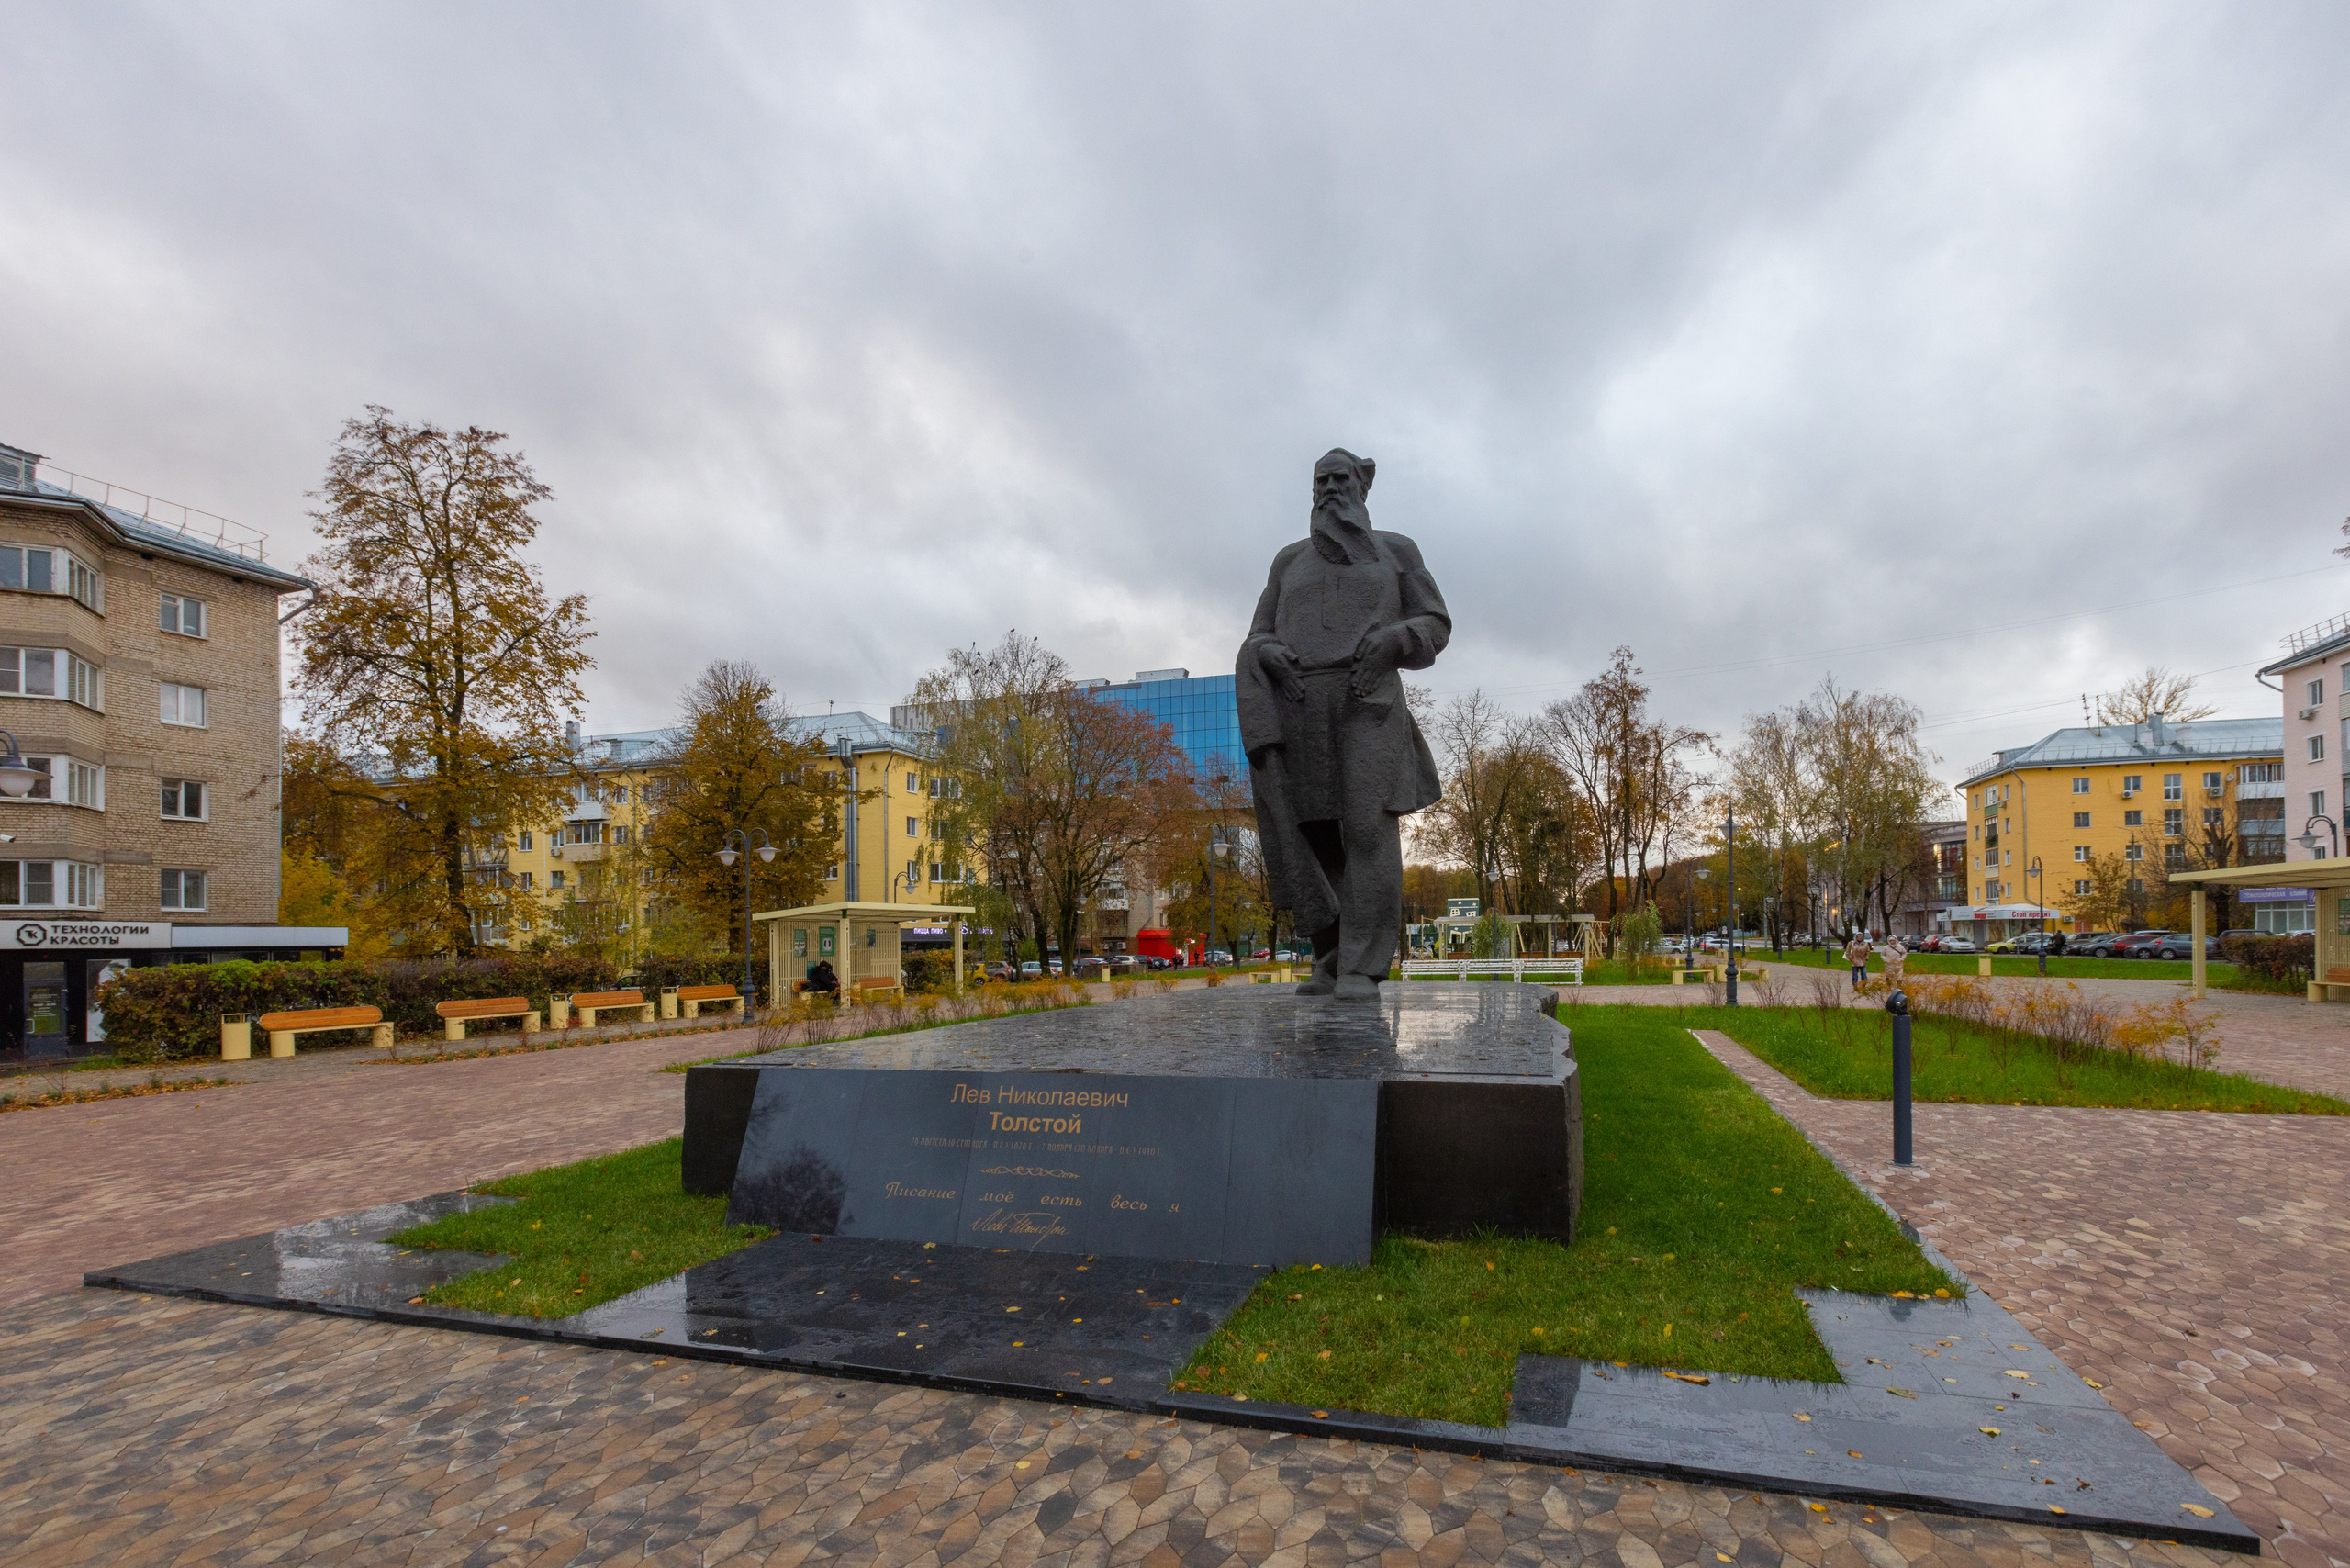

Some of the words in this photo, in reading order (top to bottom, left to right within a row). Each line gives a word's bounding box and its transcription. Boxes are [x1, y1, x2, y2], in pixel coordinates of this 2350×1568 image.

[50, 936, 119, 945] КРАСОТЫ
[51, 925, 149, 934] ТЕХНОЛОГИИ
[951, 1083, 990, 1103] Лев
[998, 1085, 1129, 1108] Николаевич
[989, 1111, 1082, 1134] Толстой
[885, 1182, 957, 1200] Писание
[979, 1191, 1015, 1203] моё
[1040, 1195, 1083, 1207] есть
[1110, 1194, 1147, 1211] весь
[1169, 1201, 1181, 1213] я
